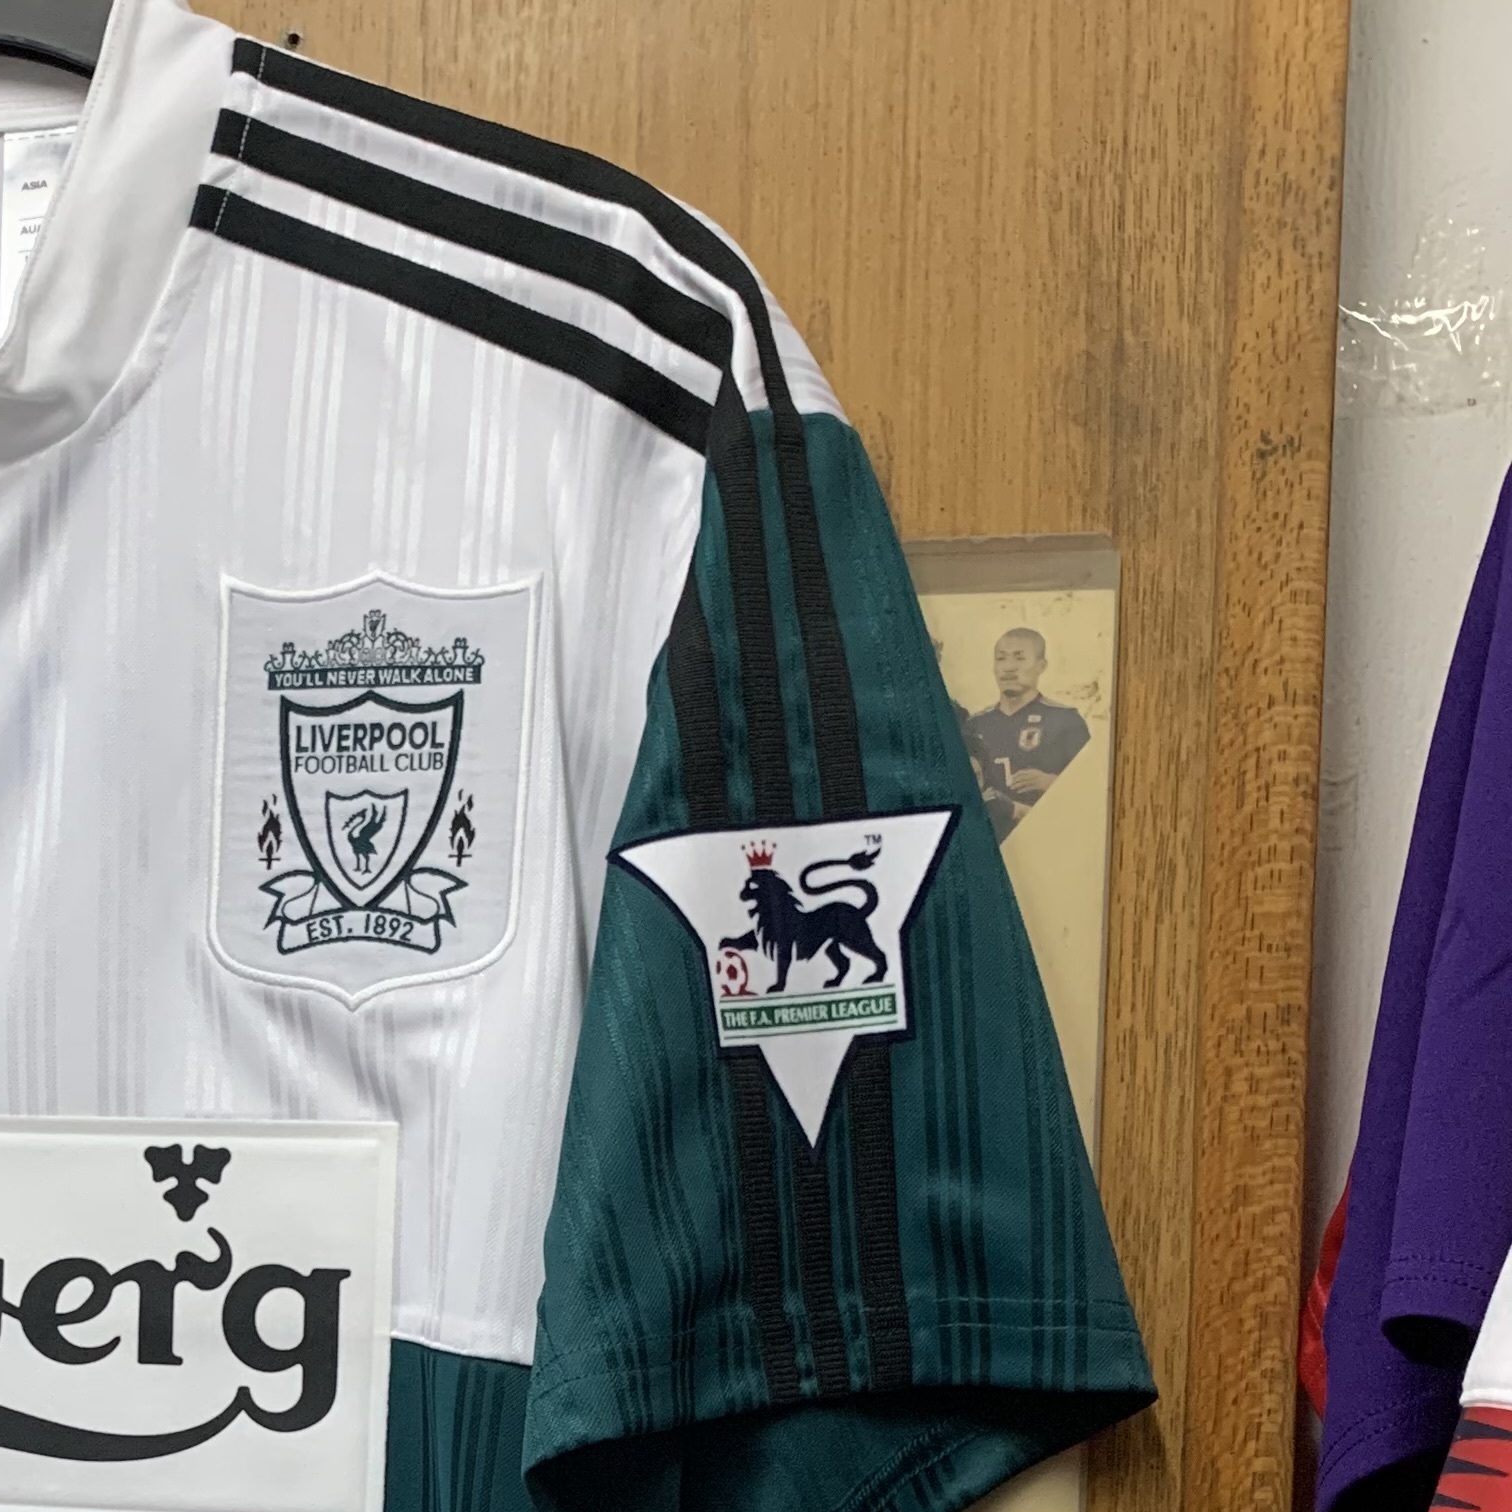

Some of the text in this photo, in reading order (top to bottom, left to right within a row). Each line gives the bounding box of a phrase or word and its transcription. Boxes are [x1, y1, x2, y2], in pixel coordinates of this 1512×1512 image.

[21, 180, 48, 191] ASIA
[275, 667, 474, 688] YOU'LL NEVER WALK ALONE
[296, 722, 445, 754] LIVERPOOL
[294, 752, 444, 775] FOOTBALL CLUB
[306, 913, 415, 943] EST. 1892
[724, 997, 893, 1028] THE F.A. PREMIER LEAGUE
